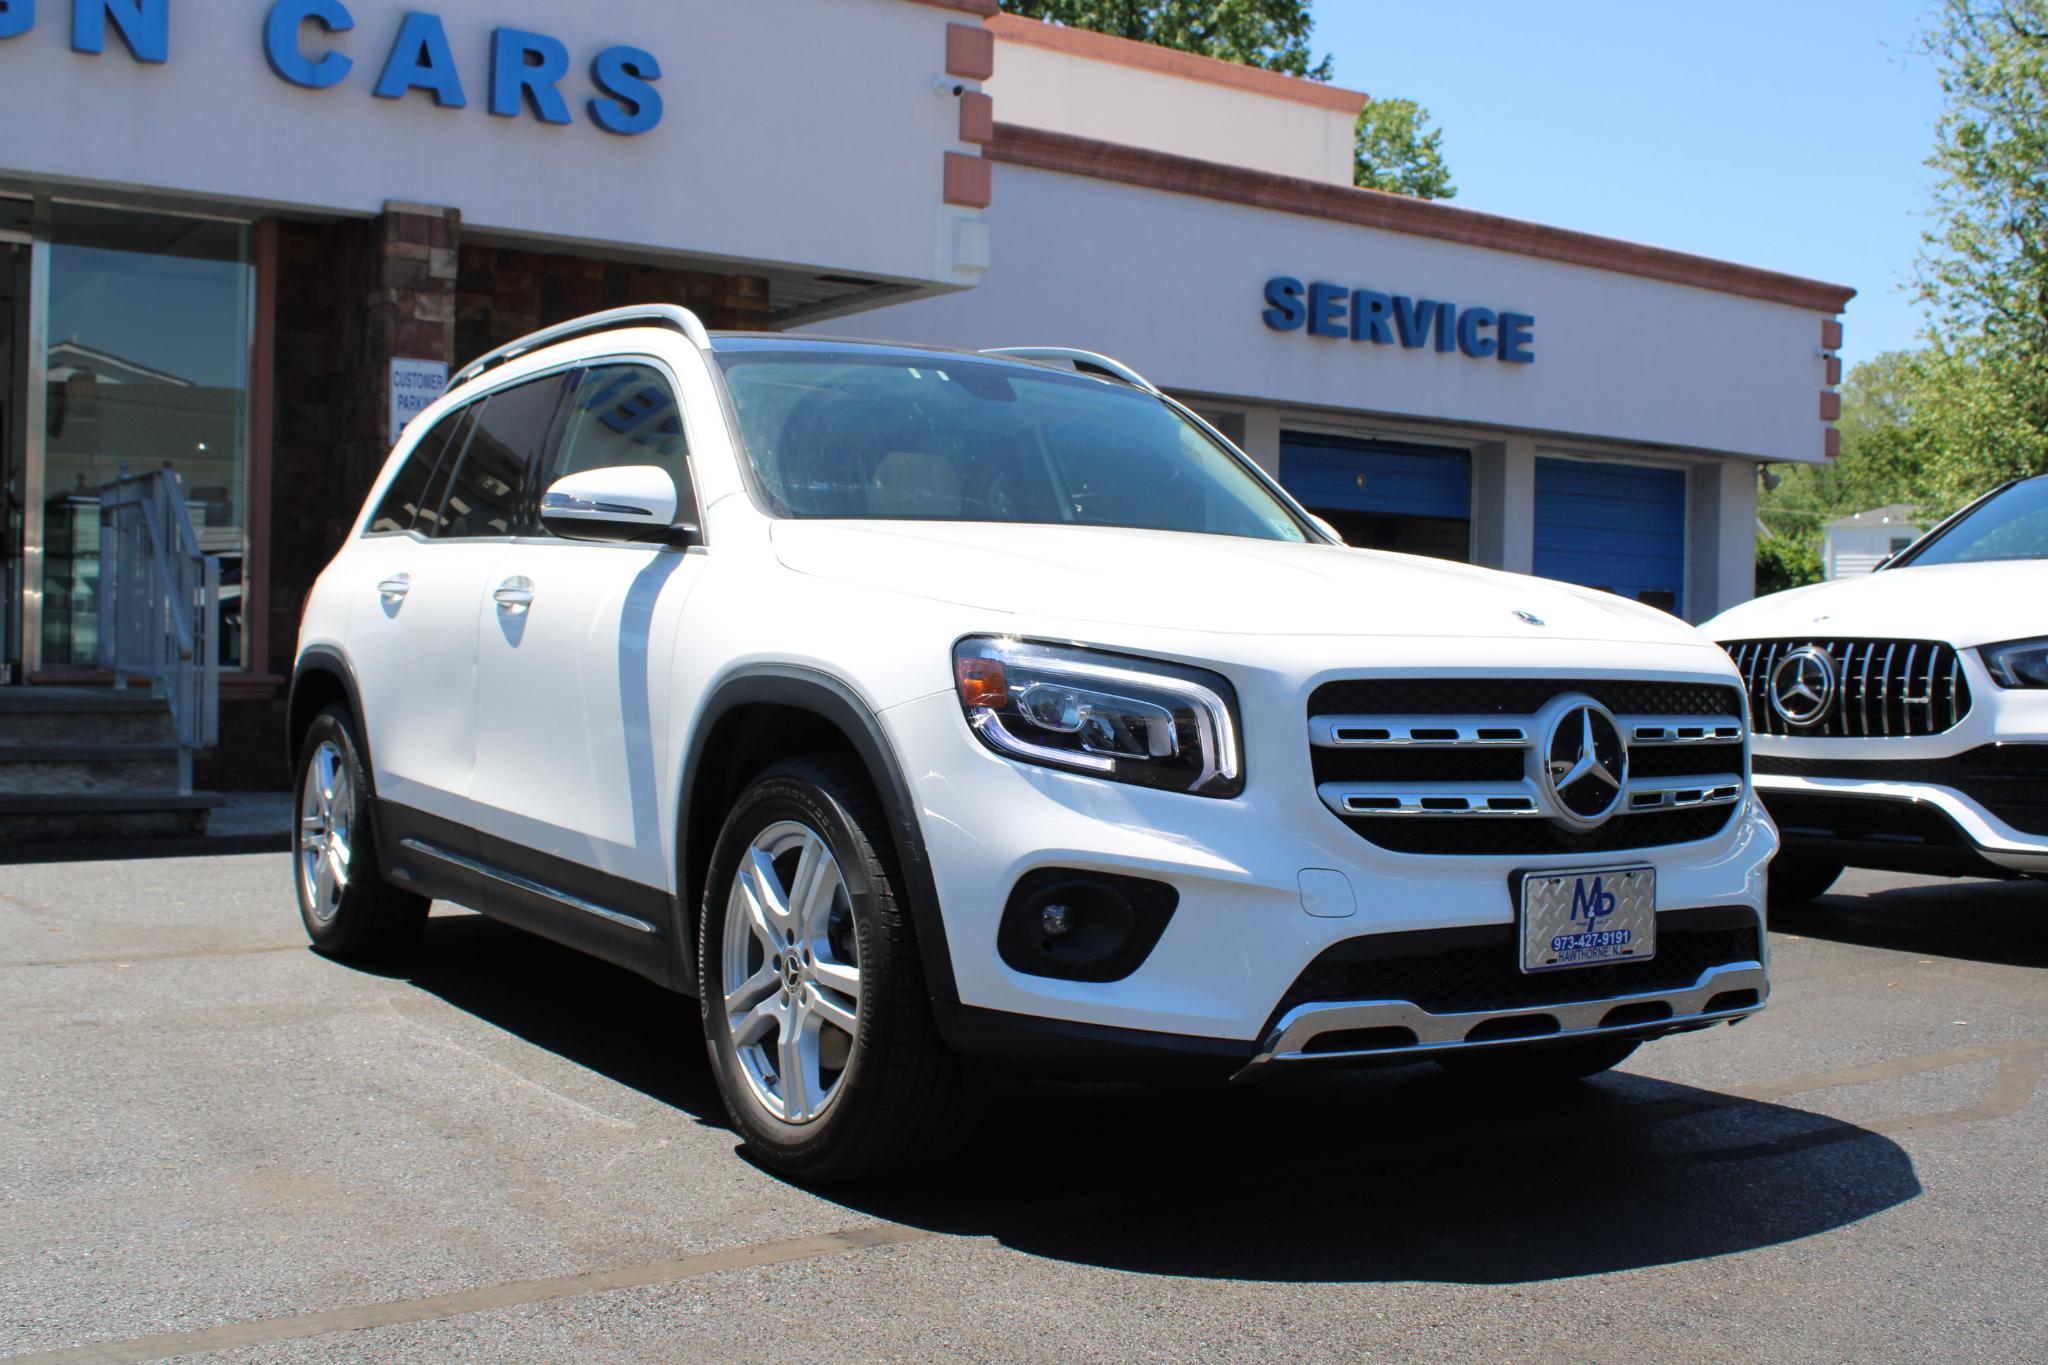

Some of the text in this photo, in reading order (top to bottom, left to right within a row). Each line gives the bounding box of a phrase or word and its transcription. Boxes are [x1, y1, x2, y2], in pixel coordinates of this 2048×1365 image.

[263, 0, 664, 135] CARS
[1262, 276, 1535, 363] SERVICE
[393, 370, 443, 390] CUSTOMER
[1553, 930, 1629, 951] 973-427-9191
